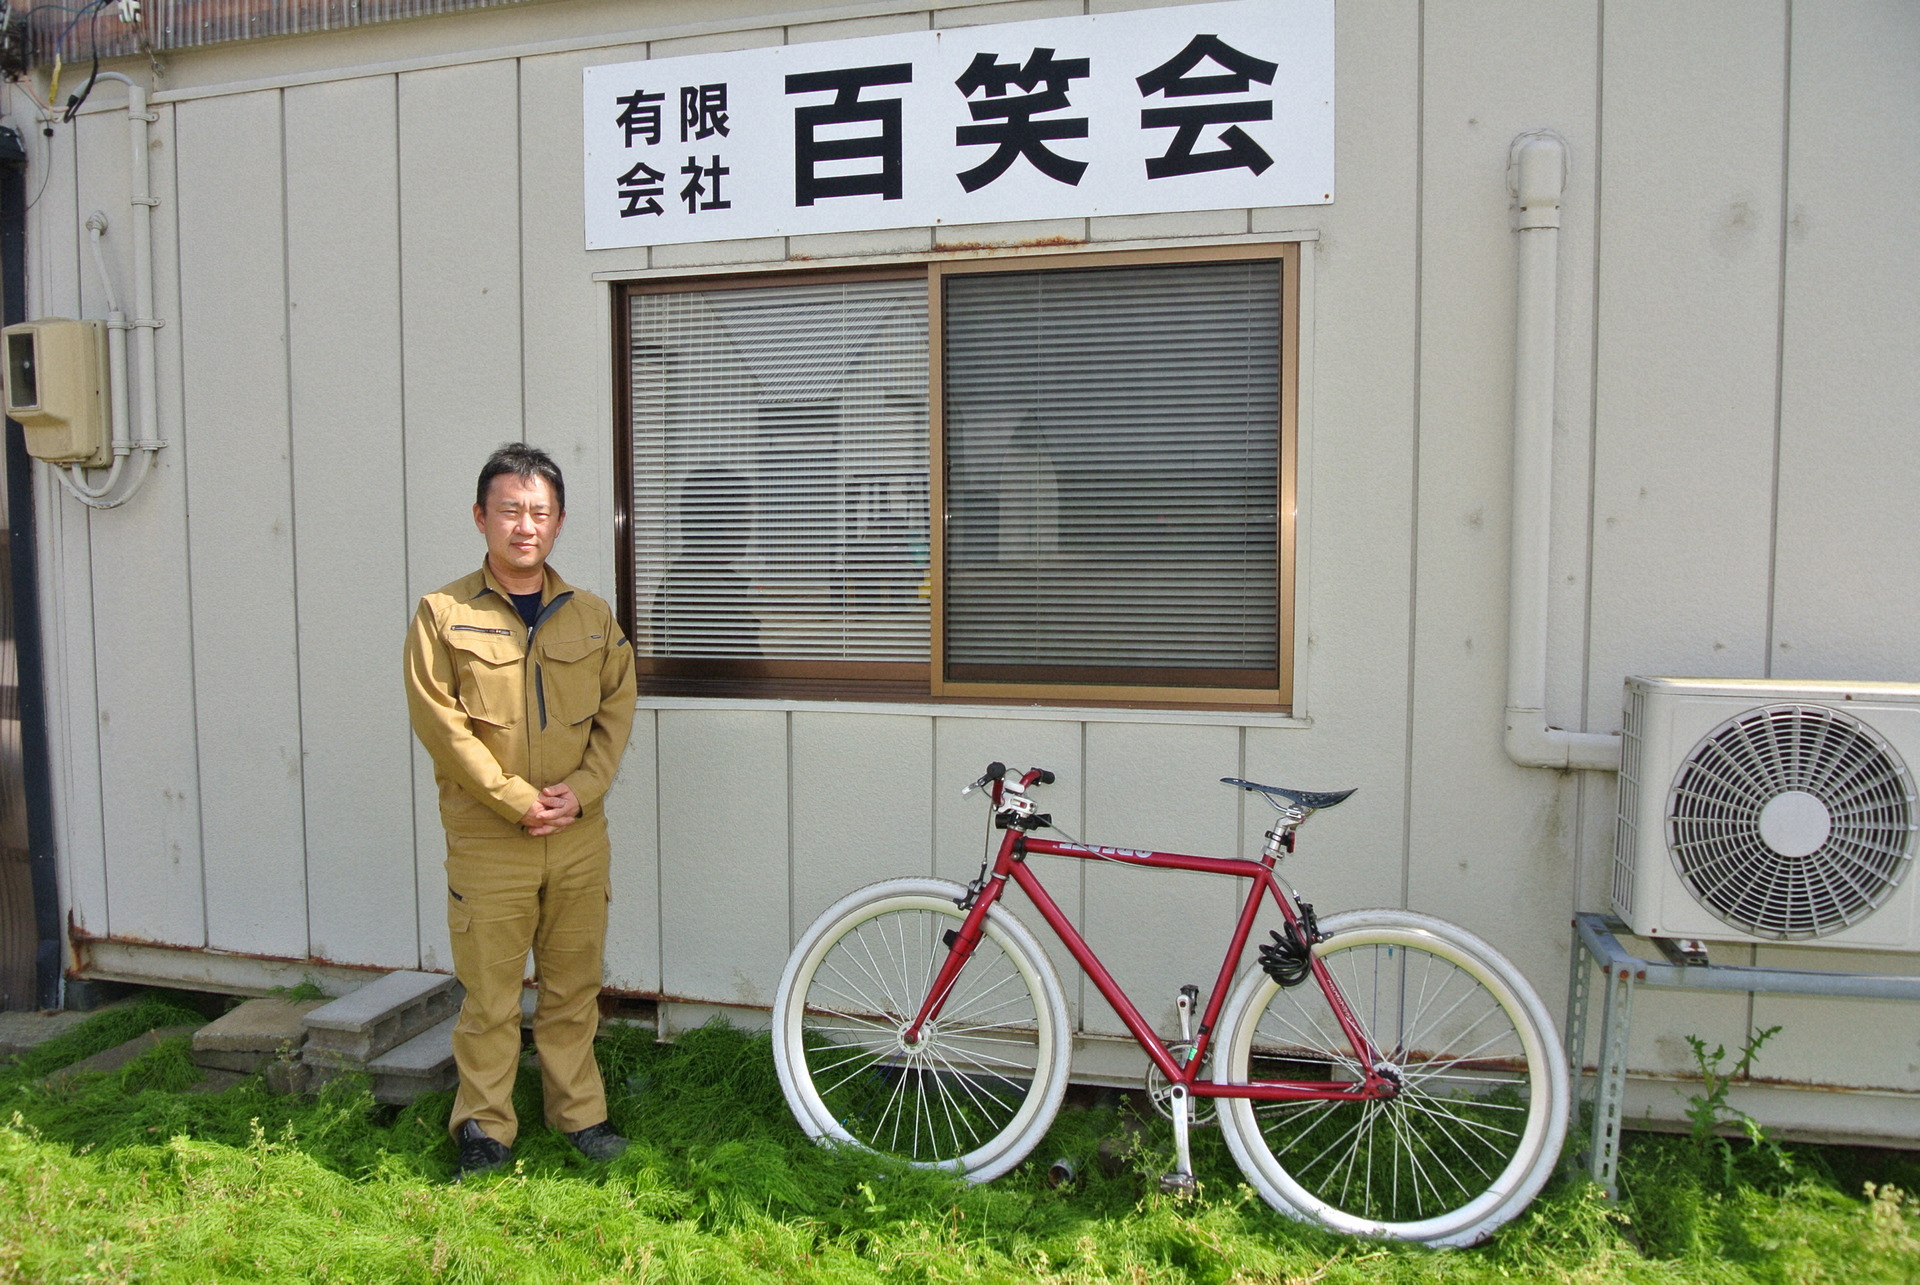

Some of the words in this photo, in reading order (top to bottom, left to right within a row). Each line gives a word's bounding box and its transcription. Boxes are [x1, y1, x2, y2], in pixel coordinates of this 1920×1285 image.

[616, 83, 730, 148] 有限
[784, 34, 1279, 207] 百笑会
[617, 155, 731, 219] 会社
